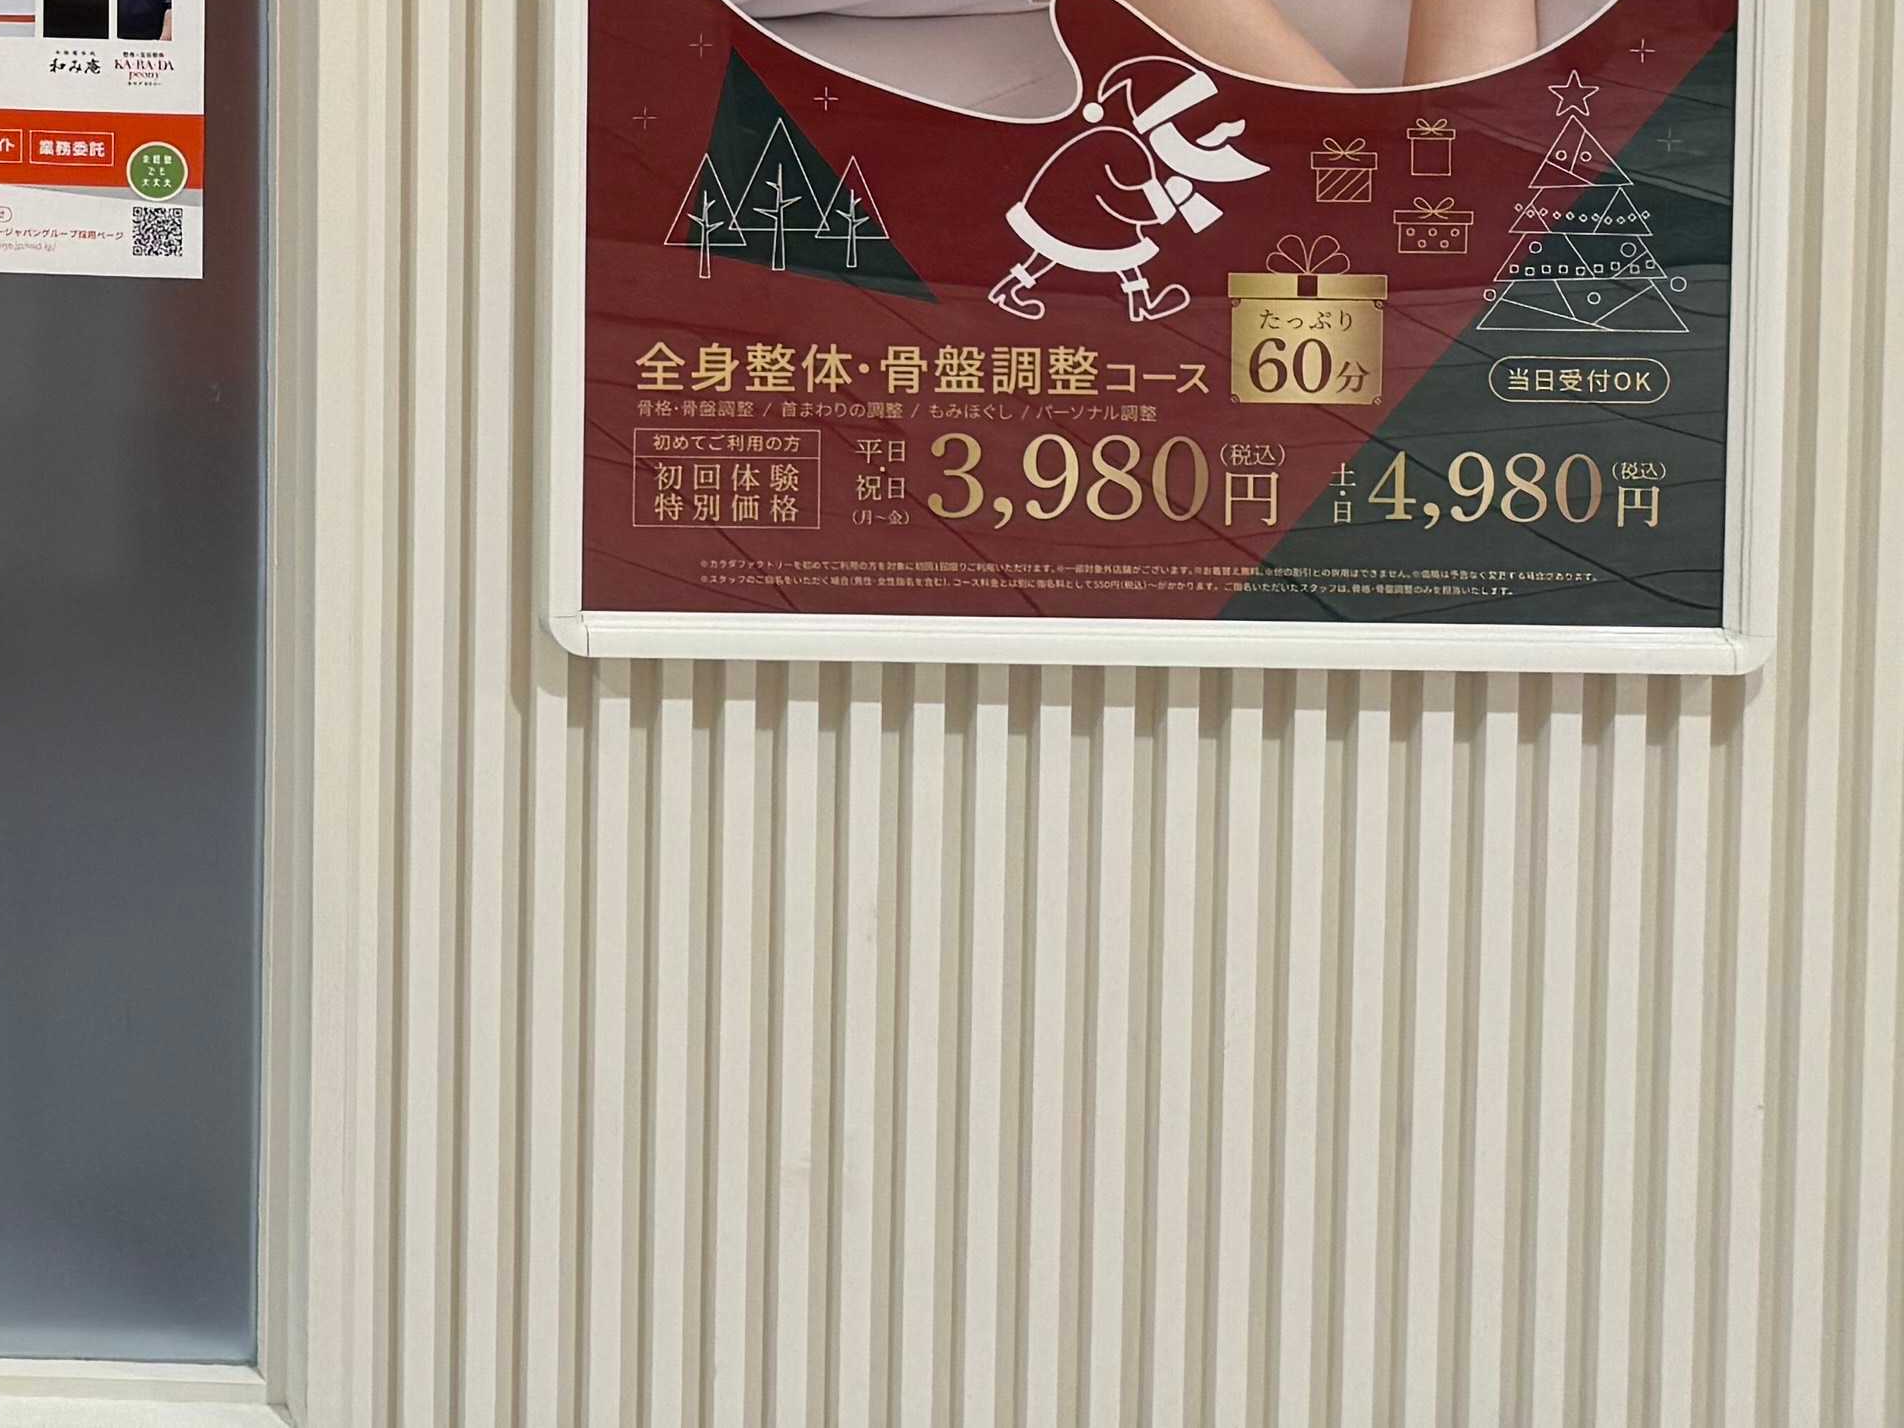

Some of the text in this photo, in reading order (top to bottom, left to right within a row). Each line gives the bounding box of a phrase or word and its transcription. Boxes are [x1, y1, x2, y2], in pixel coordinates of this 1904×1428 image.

[49, 58, 101, 74] 和み庵
[39, 139, 105, 158] 業務委託
[1259, 309, 1354, 332] たっぷり
[635, 341, 1209, 394] 全身整体・骨盤調整コース
[1249, 337, 1370, 394] 60分
[1507, 367, 1653, 393] 当日受付OK
[637, 400, 754, 418] 骨格・骨盤調整
[781, 401, 904, 419] 首まわりの調整
[929, 402, 1013, 420] もみほぐし
[1036, 404, 1158, 423] パーソナル調整
[652, 434, 801, 454] 初めてご利用の方
[856, 439, 906, 465] 平日
[1219, 443, 1286, 467] (税込)
[654, 462, 799, 493] 初回体験
[927, 432, 1278, 530] 3,980円
[1612, 461, 1667, 482] (税込)
[856, 474, 906, 501] 祝日
[1368, 450, 1661, 530] 4,980円
[654, 492, 799, 522] 特別価格
